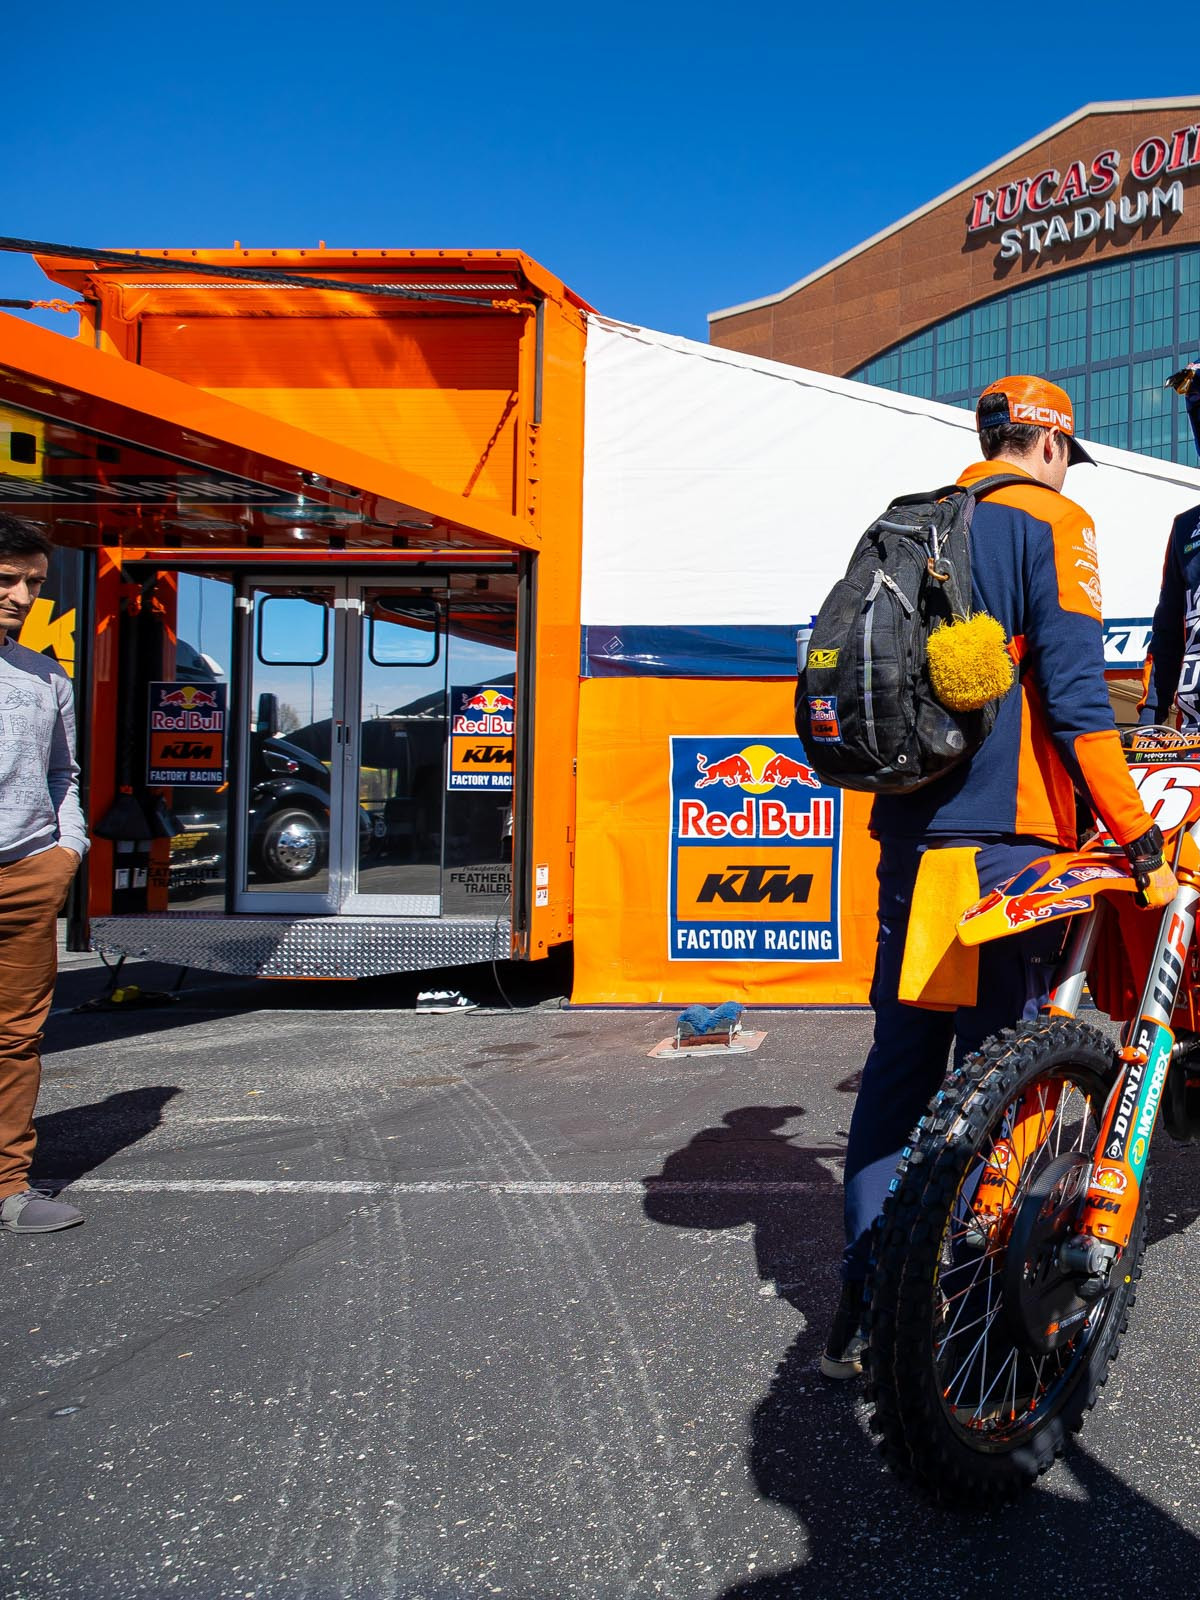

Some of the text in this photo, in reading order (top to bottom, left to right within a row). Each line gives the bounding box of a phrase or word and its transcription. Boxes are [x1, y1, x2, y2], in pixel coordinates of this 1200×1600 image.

[968, 149, 1121, 233] LUCAS
[1000, 180, 1184, 259] STADIUM
[1013, 403, 1072, 431] RACING
[1102, 626, 1153, 663] KT
[152, 711, 223, 730] Red Bull
[453, 714, 489, 733] Red
[160, 741, 213, 759] KTM
[462, 745, 513, 763] KTM
[150, 770, 223, 781] FACTORY RACING
[451, 774, 490, 786] FACTORY
[679, 797, 834, 839] Red Bull
[450, 873, 513, 883] FEATHERL
[696, 865, 814, 903] KTM
[677, 929, 833, 950] FACTORY RACING
[1114, 1029, 1152, 1138] DUNLP
[1137, 1046, 1171, 1138] MOTOREX
